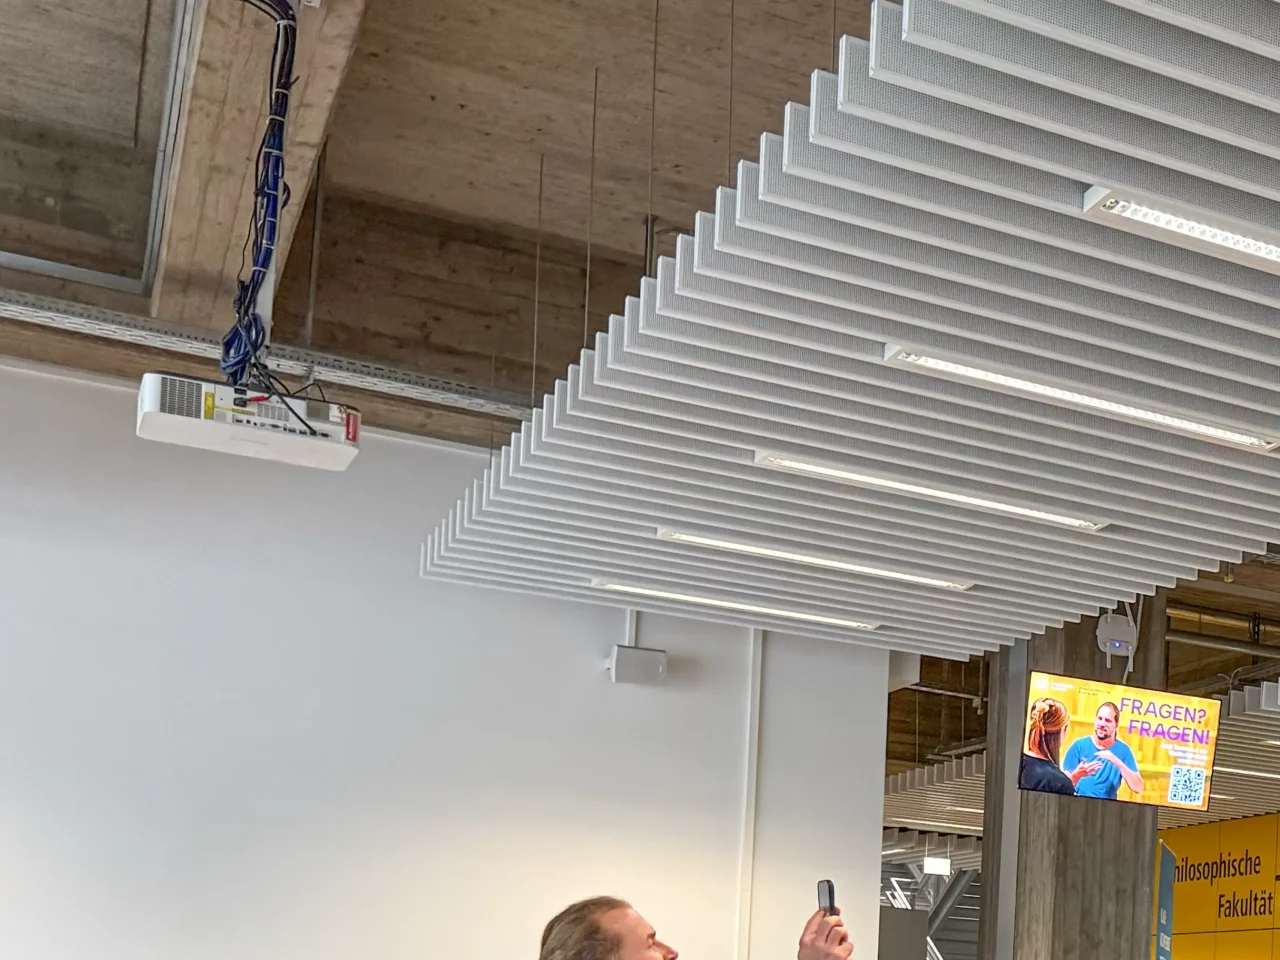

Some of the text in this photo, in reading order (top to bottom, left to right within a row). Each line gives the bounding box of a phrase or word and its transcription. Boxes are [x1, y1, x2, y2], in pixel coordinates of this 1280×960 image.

[1119, 697, 1207, 724] FRAGEN?
[1128, 719, 1210, 745] FRAGEN!
[1174, 849, 1261, 886] hilosophische
[1218, 890, 1274, 918] Fakultät
